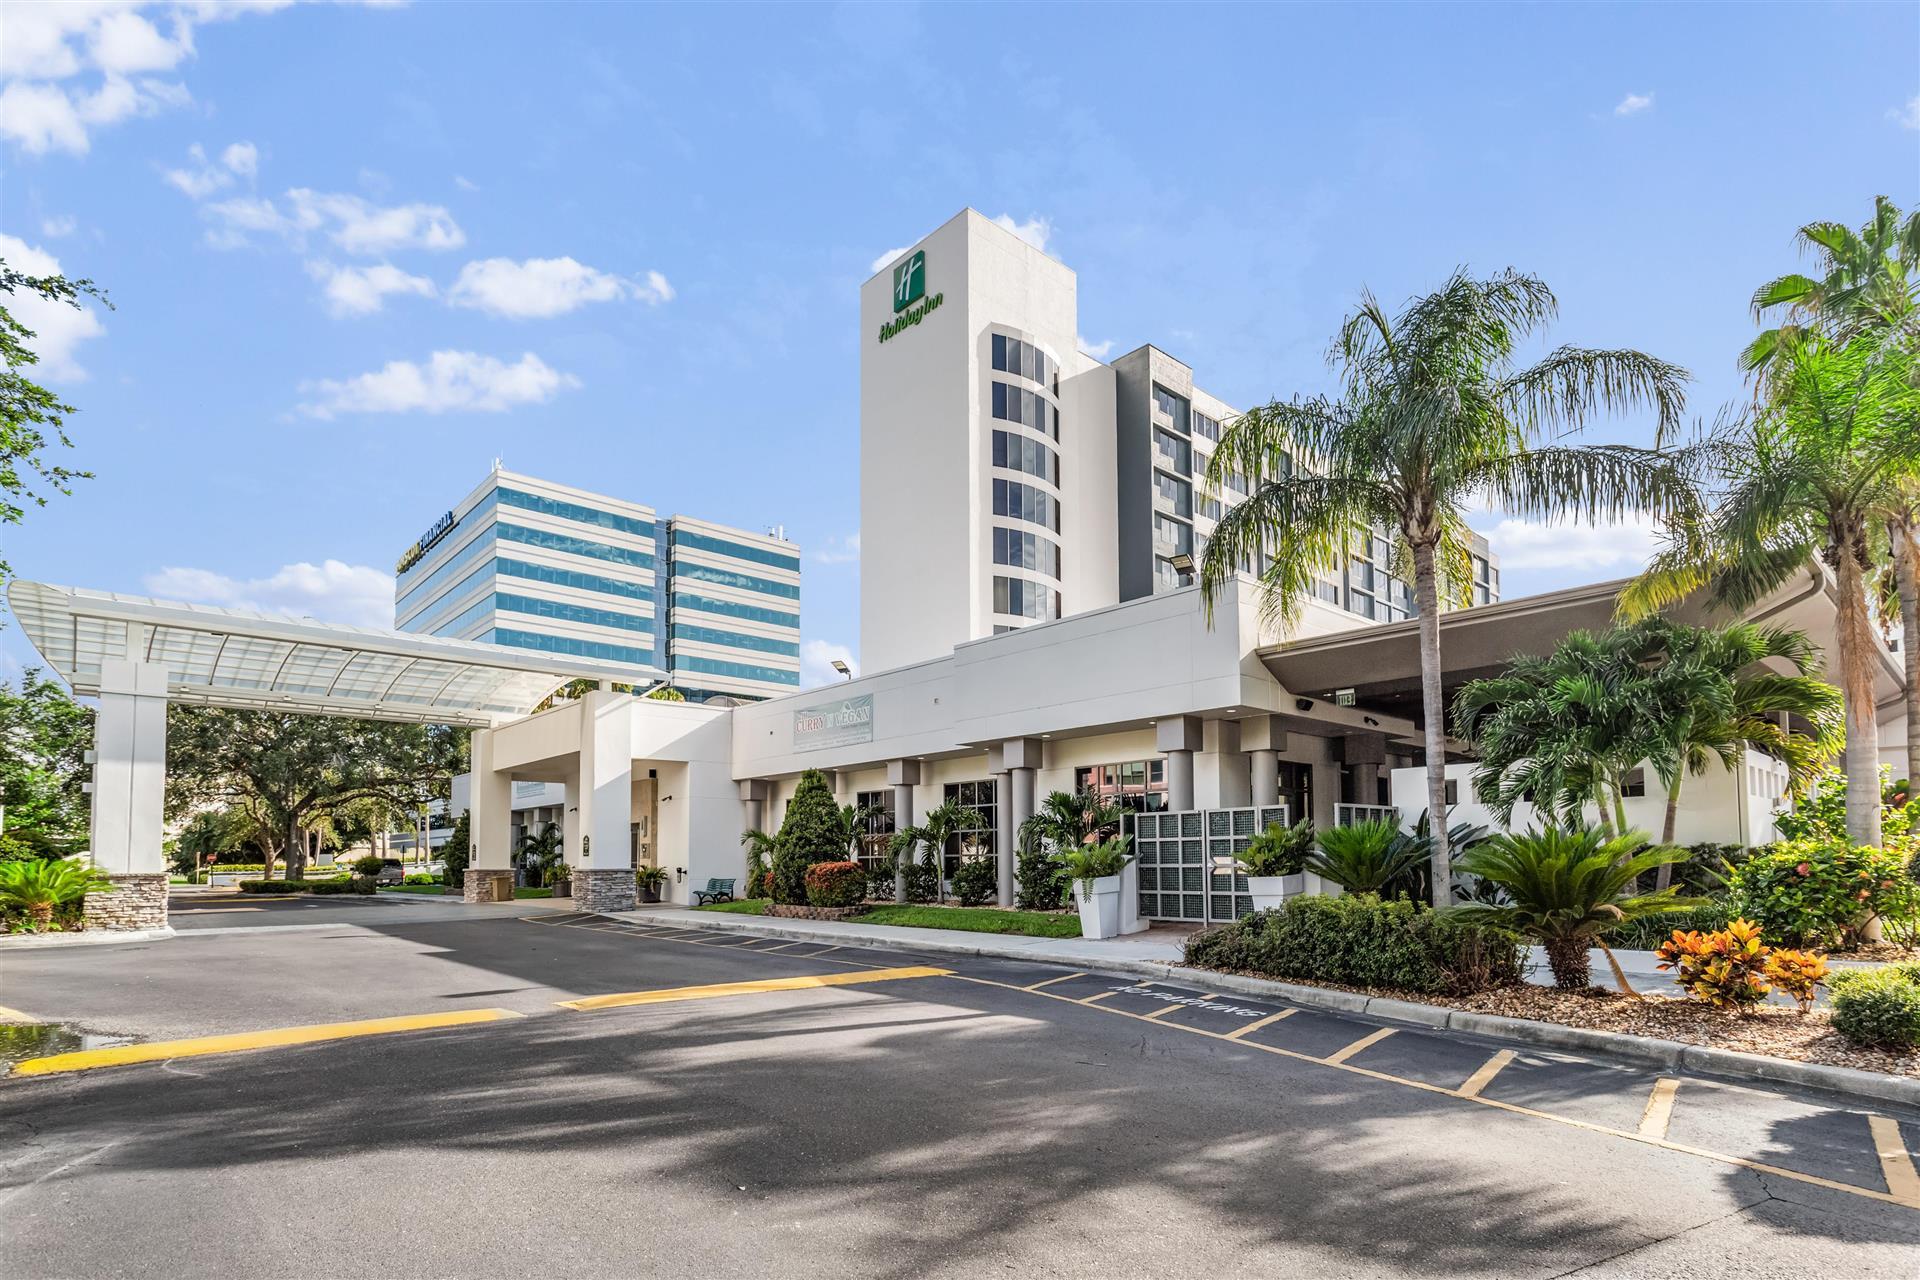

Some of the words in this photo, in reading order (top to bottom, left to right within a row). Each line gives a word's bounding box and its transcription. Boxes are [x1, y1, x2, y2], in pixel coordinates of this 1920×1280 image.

[879, 305, 923, 343] Holiday
[924, 293, 943, 315] Inn
[796, 716, 823, 733] CURRY
[834, 706, 871, 727] VEGAN
[1107, 986, 1152, 994] NO
[1140, 992, 1267, 1017] PARKING
